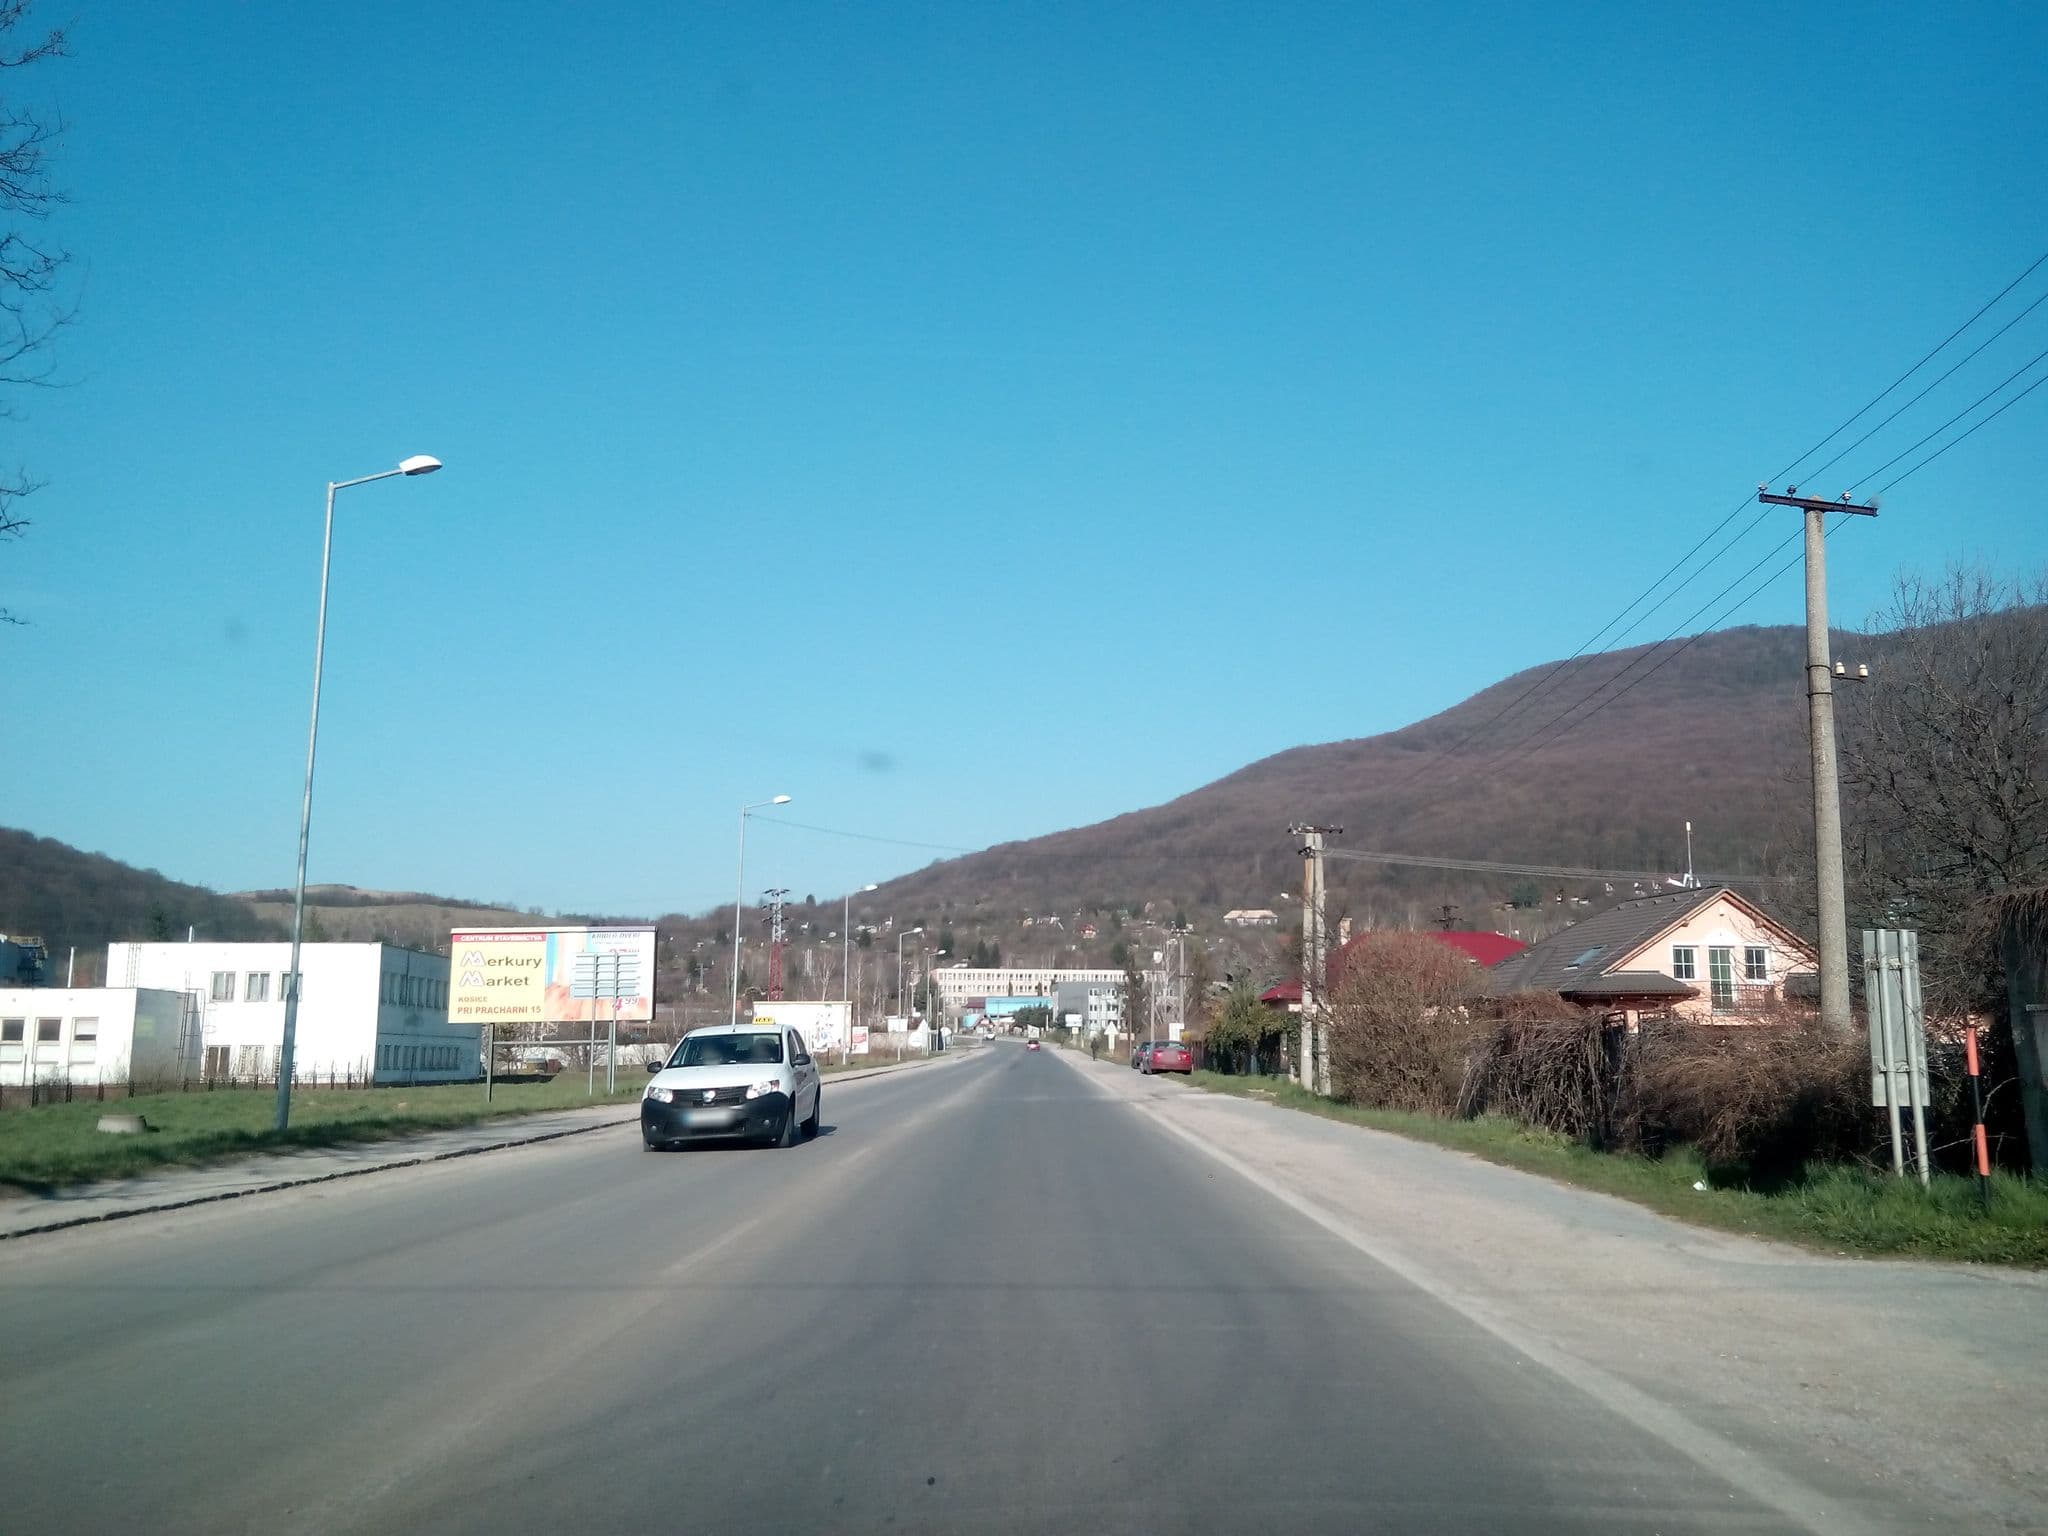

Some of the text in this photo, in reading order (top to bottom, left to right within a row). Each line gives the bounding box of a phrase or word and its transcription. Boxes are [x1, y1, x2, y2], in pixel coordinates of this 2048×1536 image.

[460, 950, 542, 969] Merkury
[458, 970, 529, 987] Market
[457, 1006, 472, 1014] PRI
[531, 1005, 542, 1013] 15
